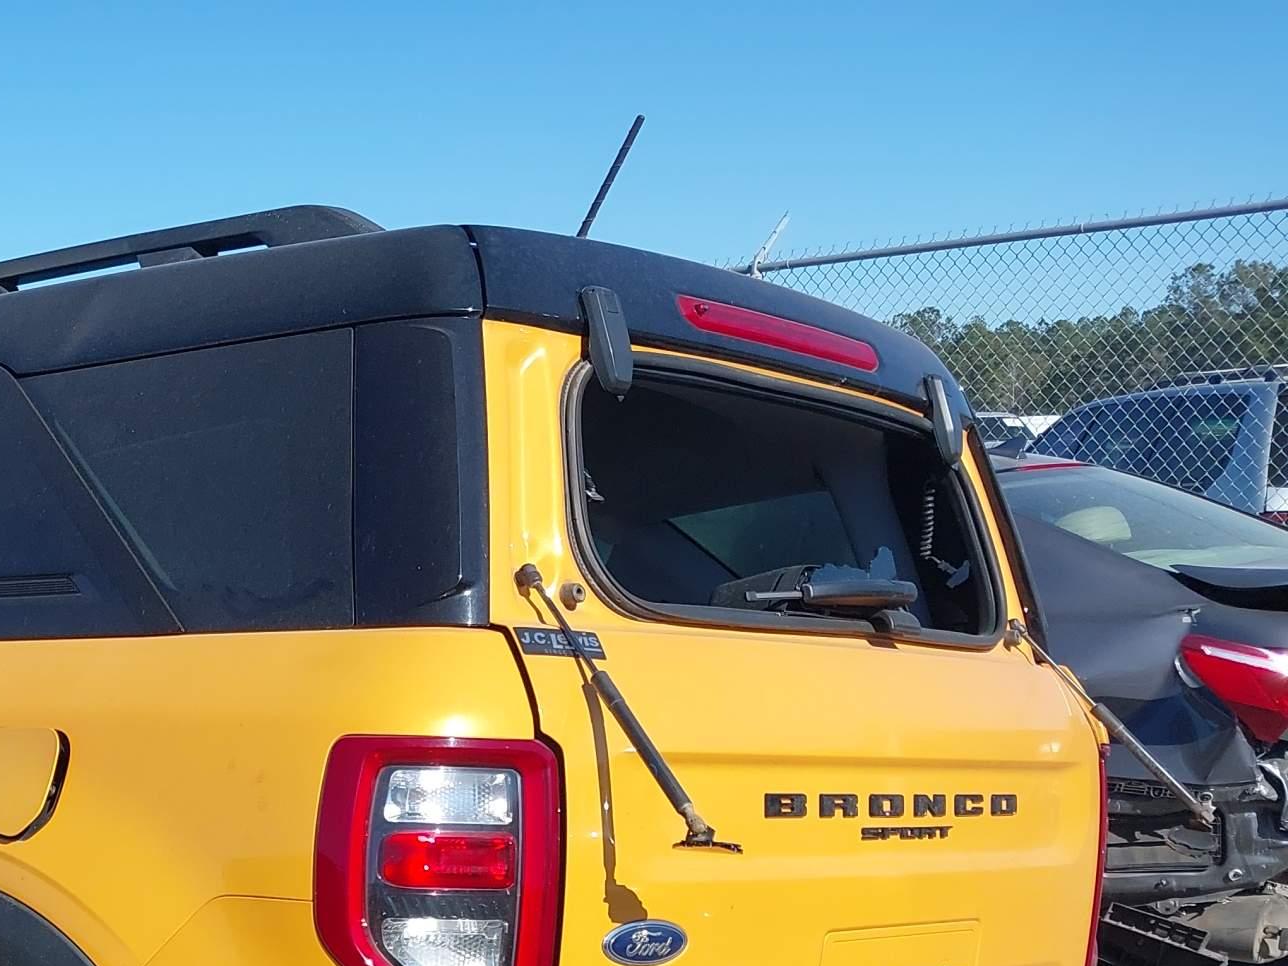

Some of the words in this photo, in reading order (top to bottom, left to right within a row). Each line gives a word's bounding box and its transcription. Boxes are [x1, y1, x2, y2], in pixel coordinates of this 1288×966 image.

[763, 793, 1018, 819] BRONCO
[861, 825, 953, 841] SPORT
[625, 929, 673, 958] Ford
